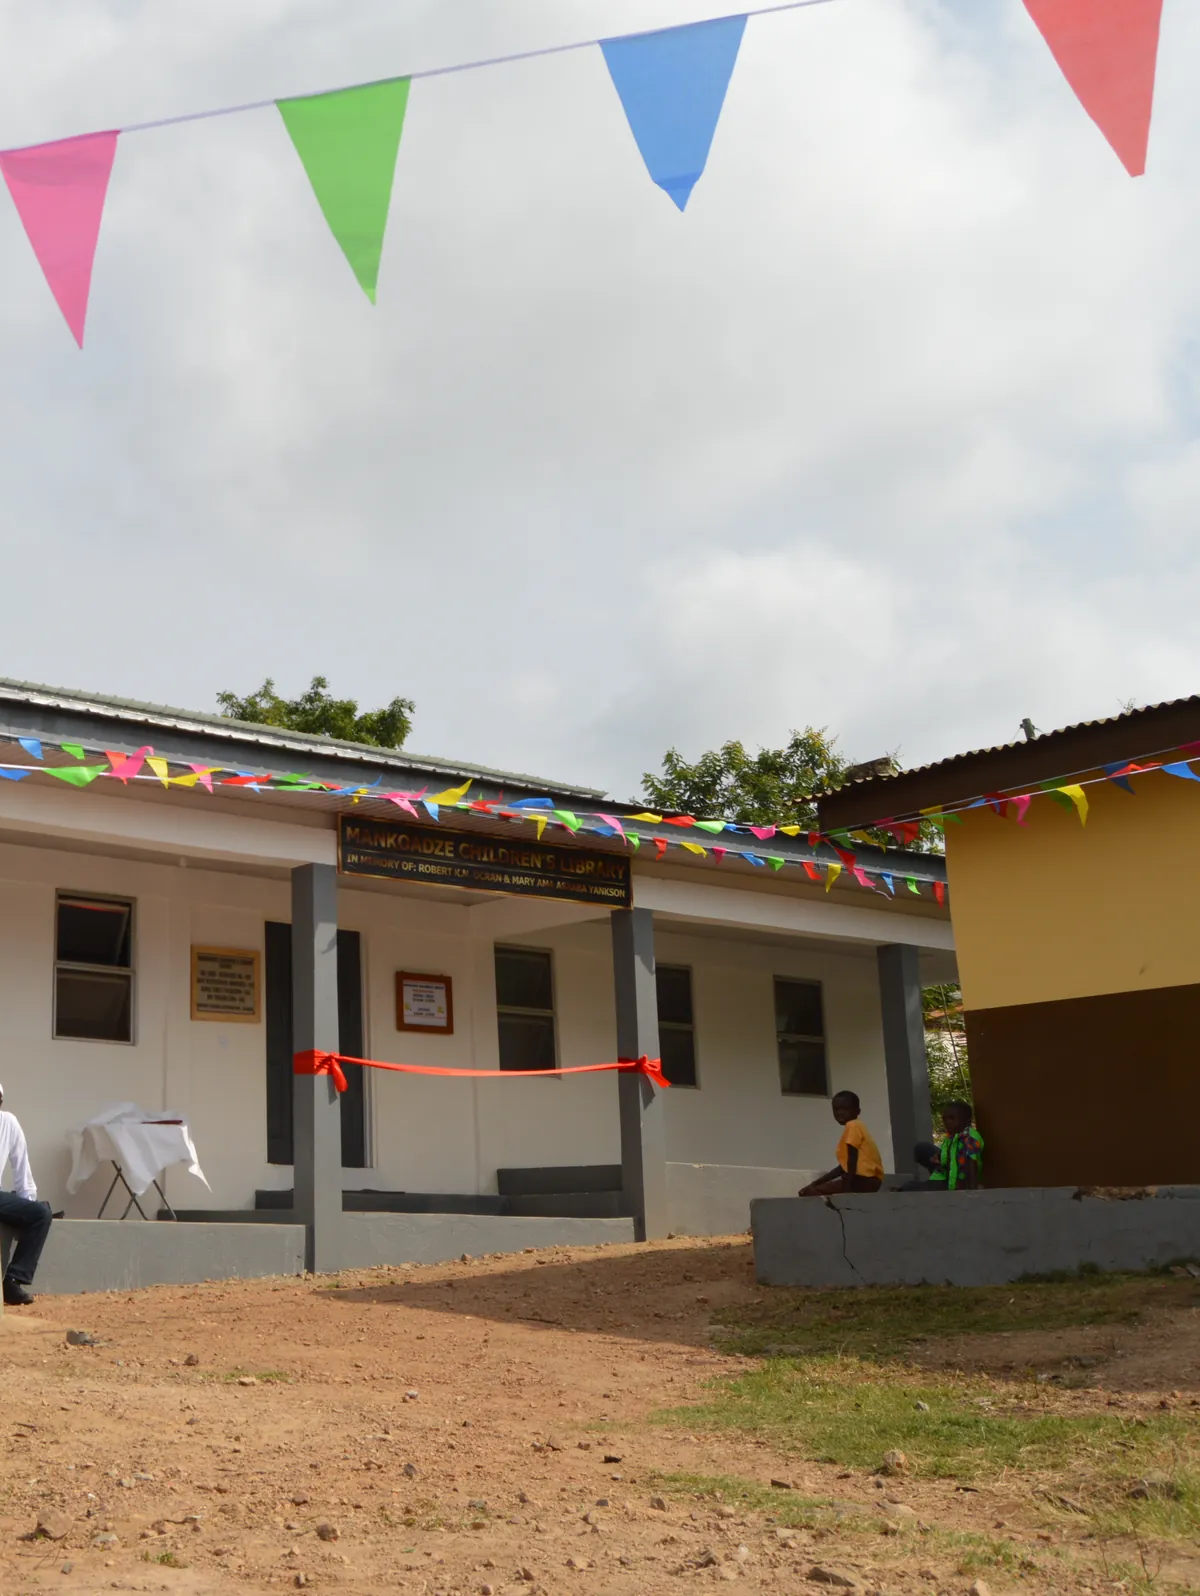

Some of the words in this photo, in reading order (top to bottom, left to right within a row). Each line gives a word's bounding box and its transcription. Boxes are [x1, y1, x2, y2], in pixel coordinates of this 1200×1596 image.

[345, 826, 455, 857] MANKOADZE
[459, 843, 556, 869] CHILDREN'S
[561, 858, 626, 879] LIBRARY
[347, 854, 359, 863] IN
[402, 862, 417, 872] OF:
[419, 864, 453, 876] ROBERT
[504, 875, 511, 884] &
[512, 876, 535, 887] MARY
[589, 886, 625, 898] YANKSON
